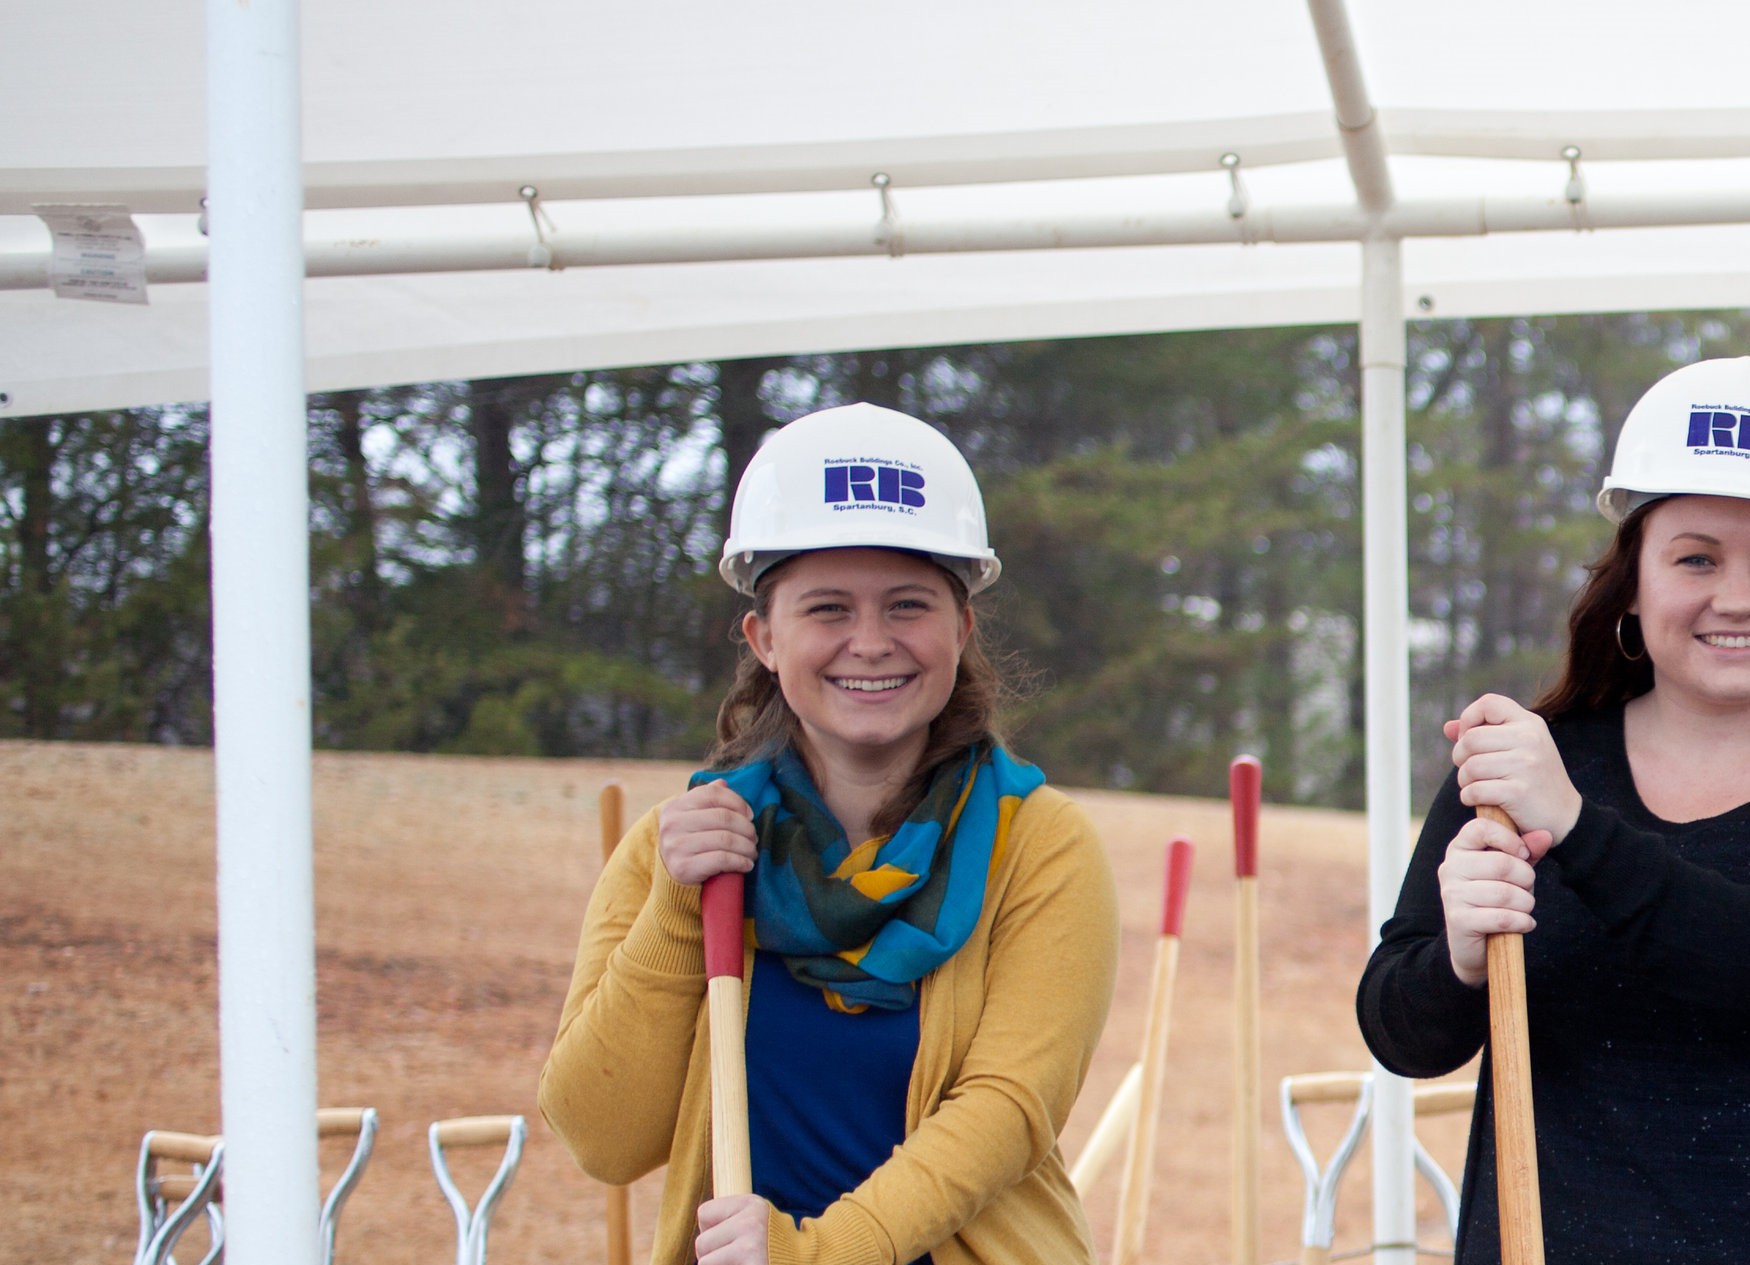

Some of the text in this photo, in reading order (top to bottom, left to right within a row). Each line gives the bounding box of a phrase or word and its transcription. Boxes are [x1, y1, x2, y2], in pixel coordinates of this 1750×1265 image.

[825, 466, 925, 507] RB
[833, 503, 917, 515] Spartanburg, S.C.
